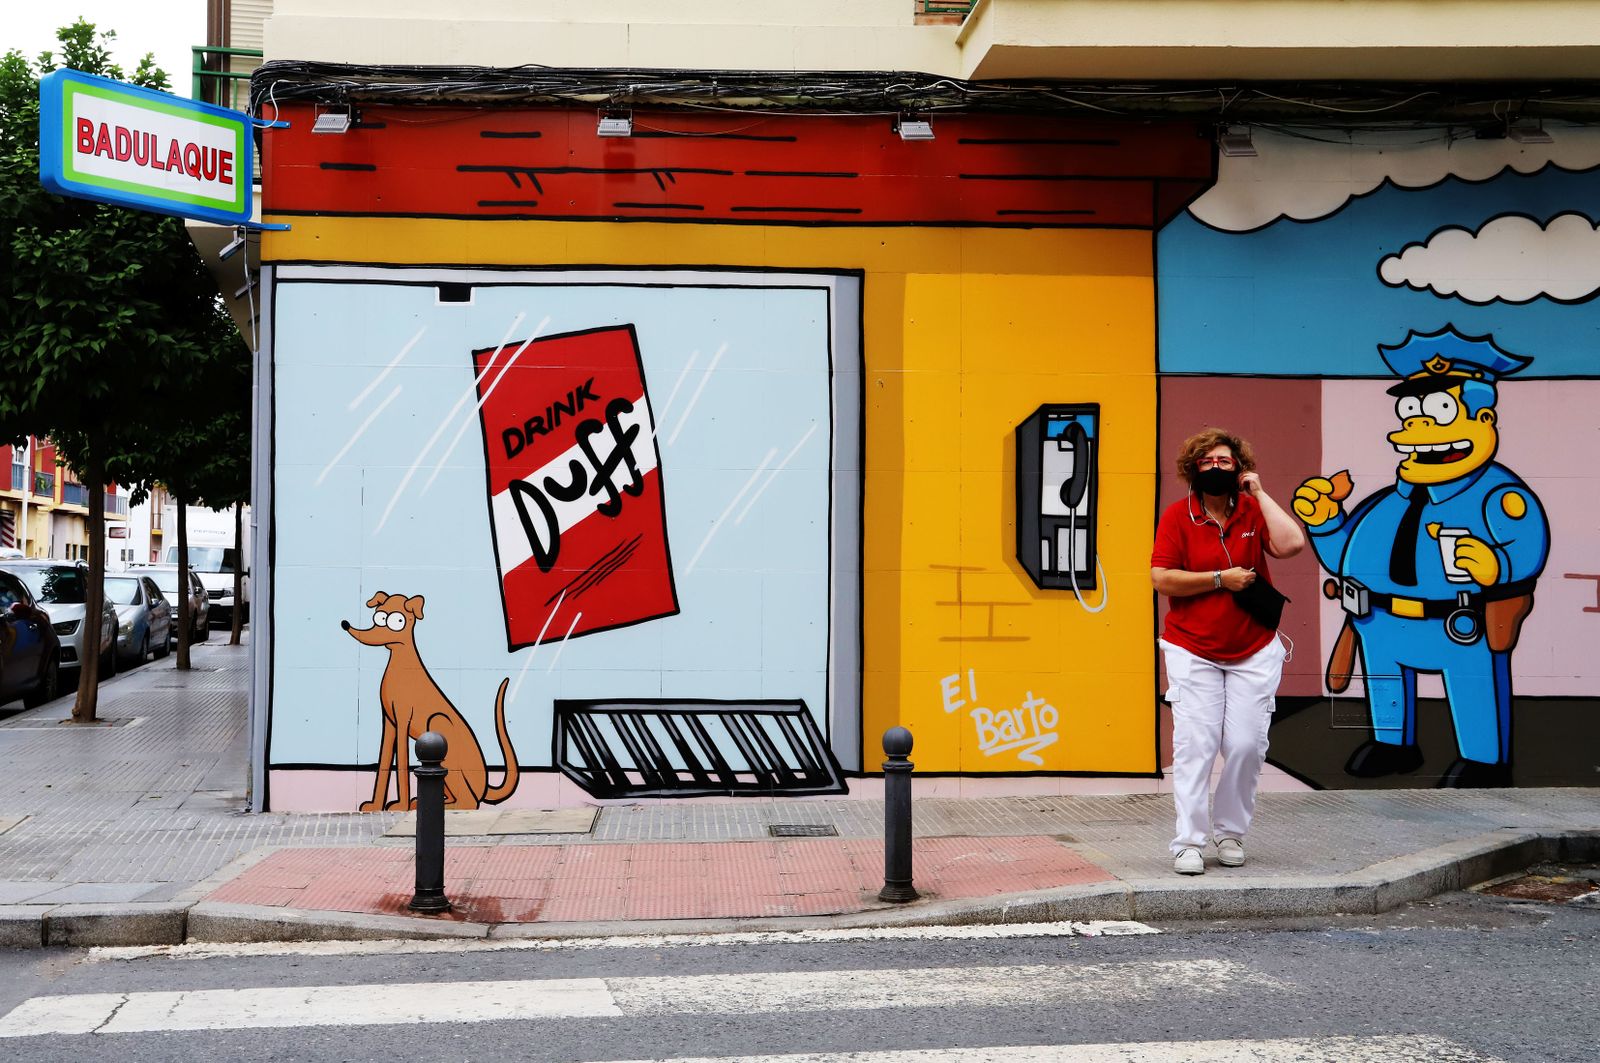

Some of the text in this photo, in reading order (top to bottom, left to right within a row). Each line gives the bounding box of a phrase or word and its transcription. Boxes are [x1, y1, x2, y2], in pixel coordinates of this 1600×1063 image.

[77, 117, 233, 185] BADULAQUE
[502, 377, 601, 459] DRINK
[509, 398, 644, 573] Duff
[940, 668, 977, 713] El
[970, 691, 1059, 750] Barto
